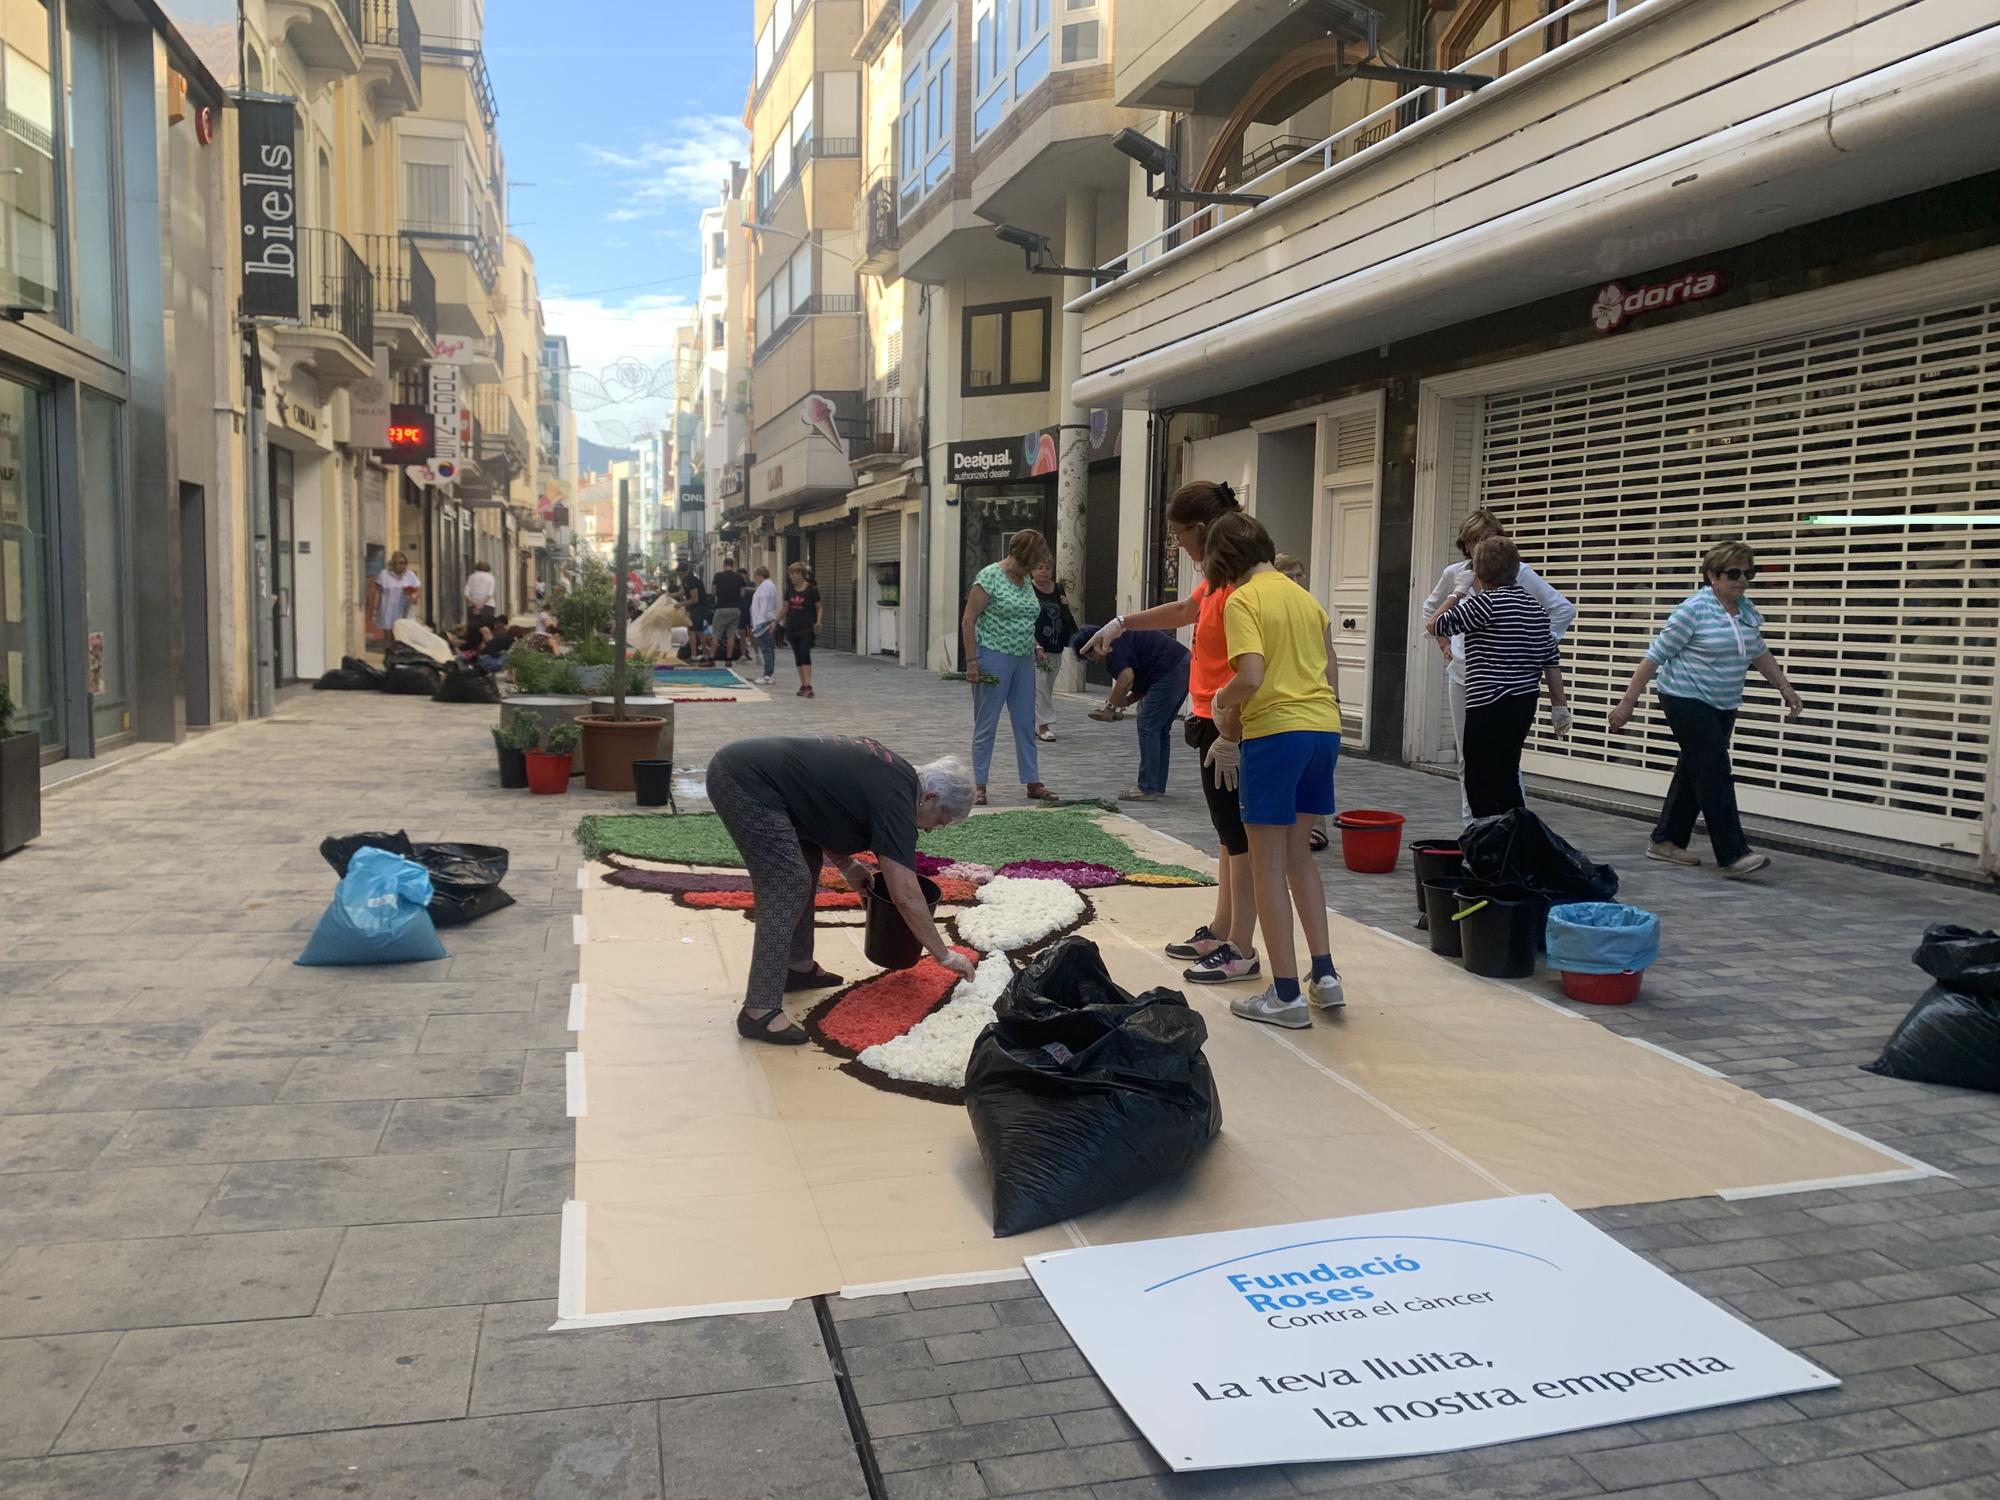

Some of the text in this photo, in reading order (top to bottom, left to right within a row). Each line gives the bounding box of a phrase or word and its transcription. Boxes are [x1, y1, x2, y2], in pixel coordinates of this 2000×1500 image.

[243, 144, 295, 278] biels
[1624, 274, 1716, 312] doria
[954, 469, 1010, 481] authorized dealer
[681, 493, 705, 502] ONL
[1227, 1254, 1421, 1292] Fundació
[1244, 1285, 1376, 1313] Roses
[1267, 1291, 1495, 1330] Contra el càncer
[1192, 1351, 1494, 1401] La teva lluita,
[1312, 1354, 1736, 1429] la nostra empenta
